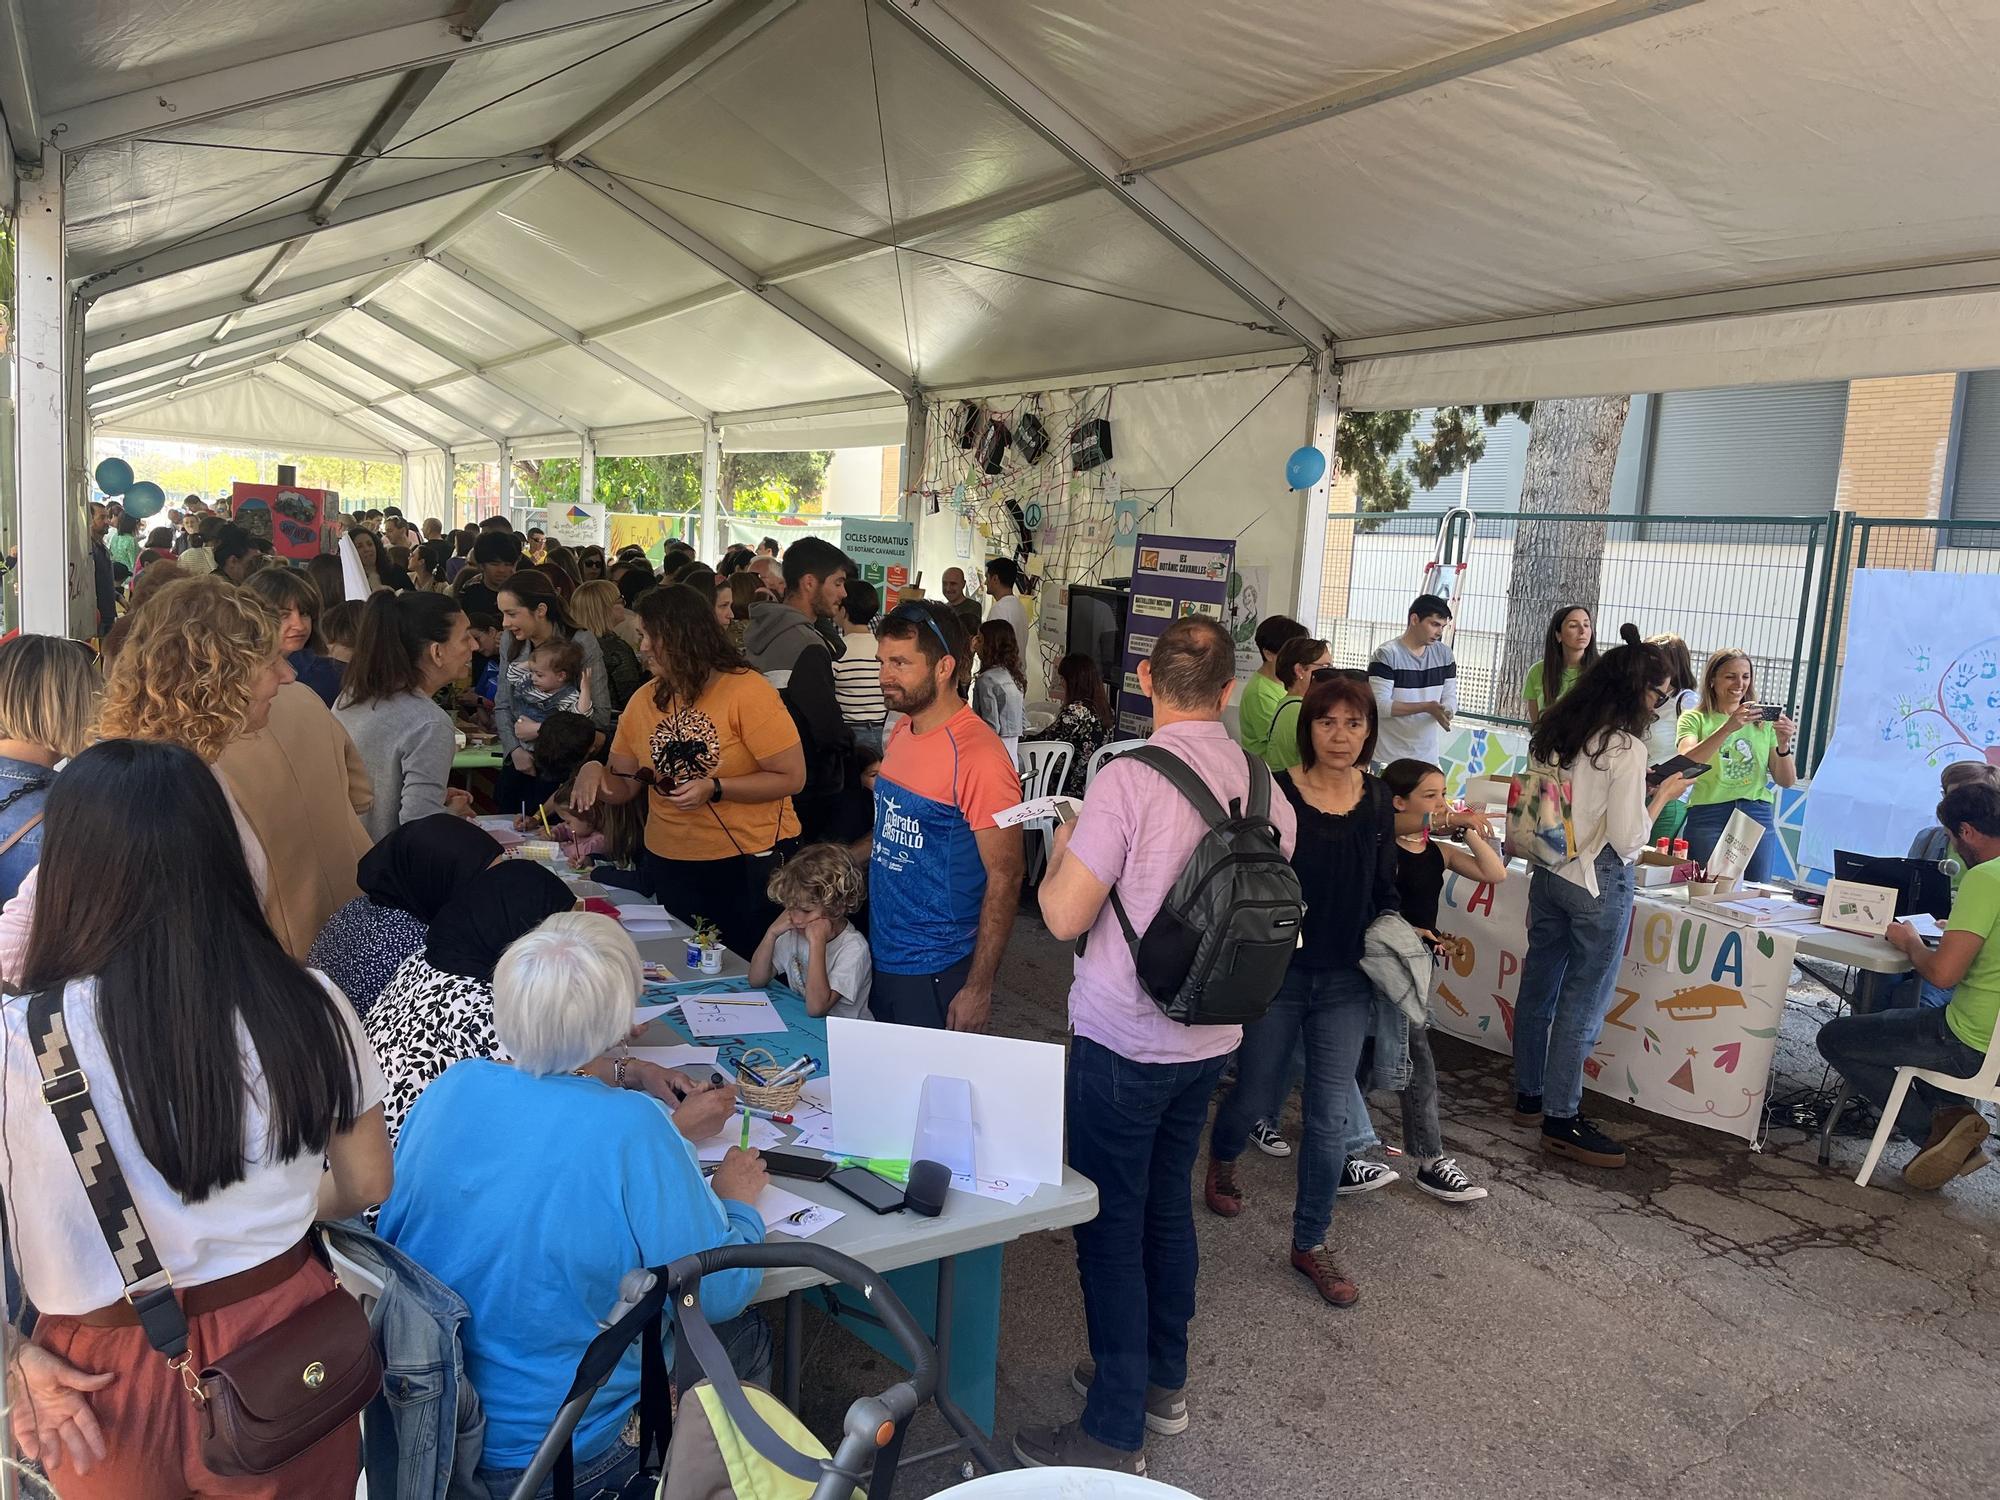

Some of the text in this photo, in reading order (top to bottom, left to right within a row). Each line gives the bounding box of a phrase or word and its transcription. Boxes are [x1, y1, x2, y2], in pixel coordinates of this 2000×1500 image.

[844, 533, 909, 546] CICLES FORMATIUS
[1179, 554, 1188, 562] IES
[1179, 564, 1207, 574] CAVANILLES
